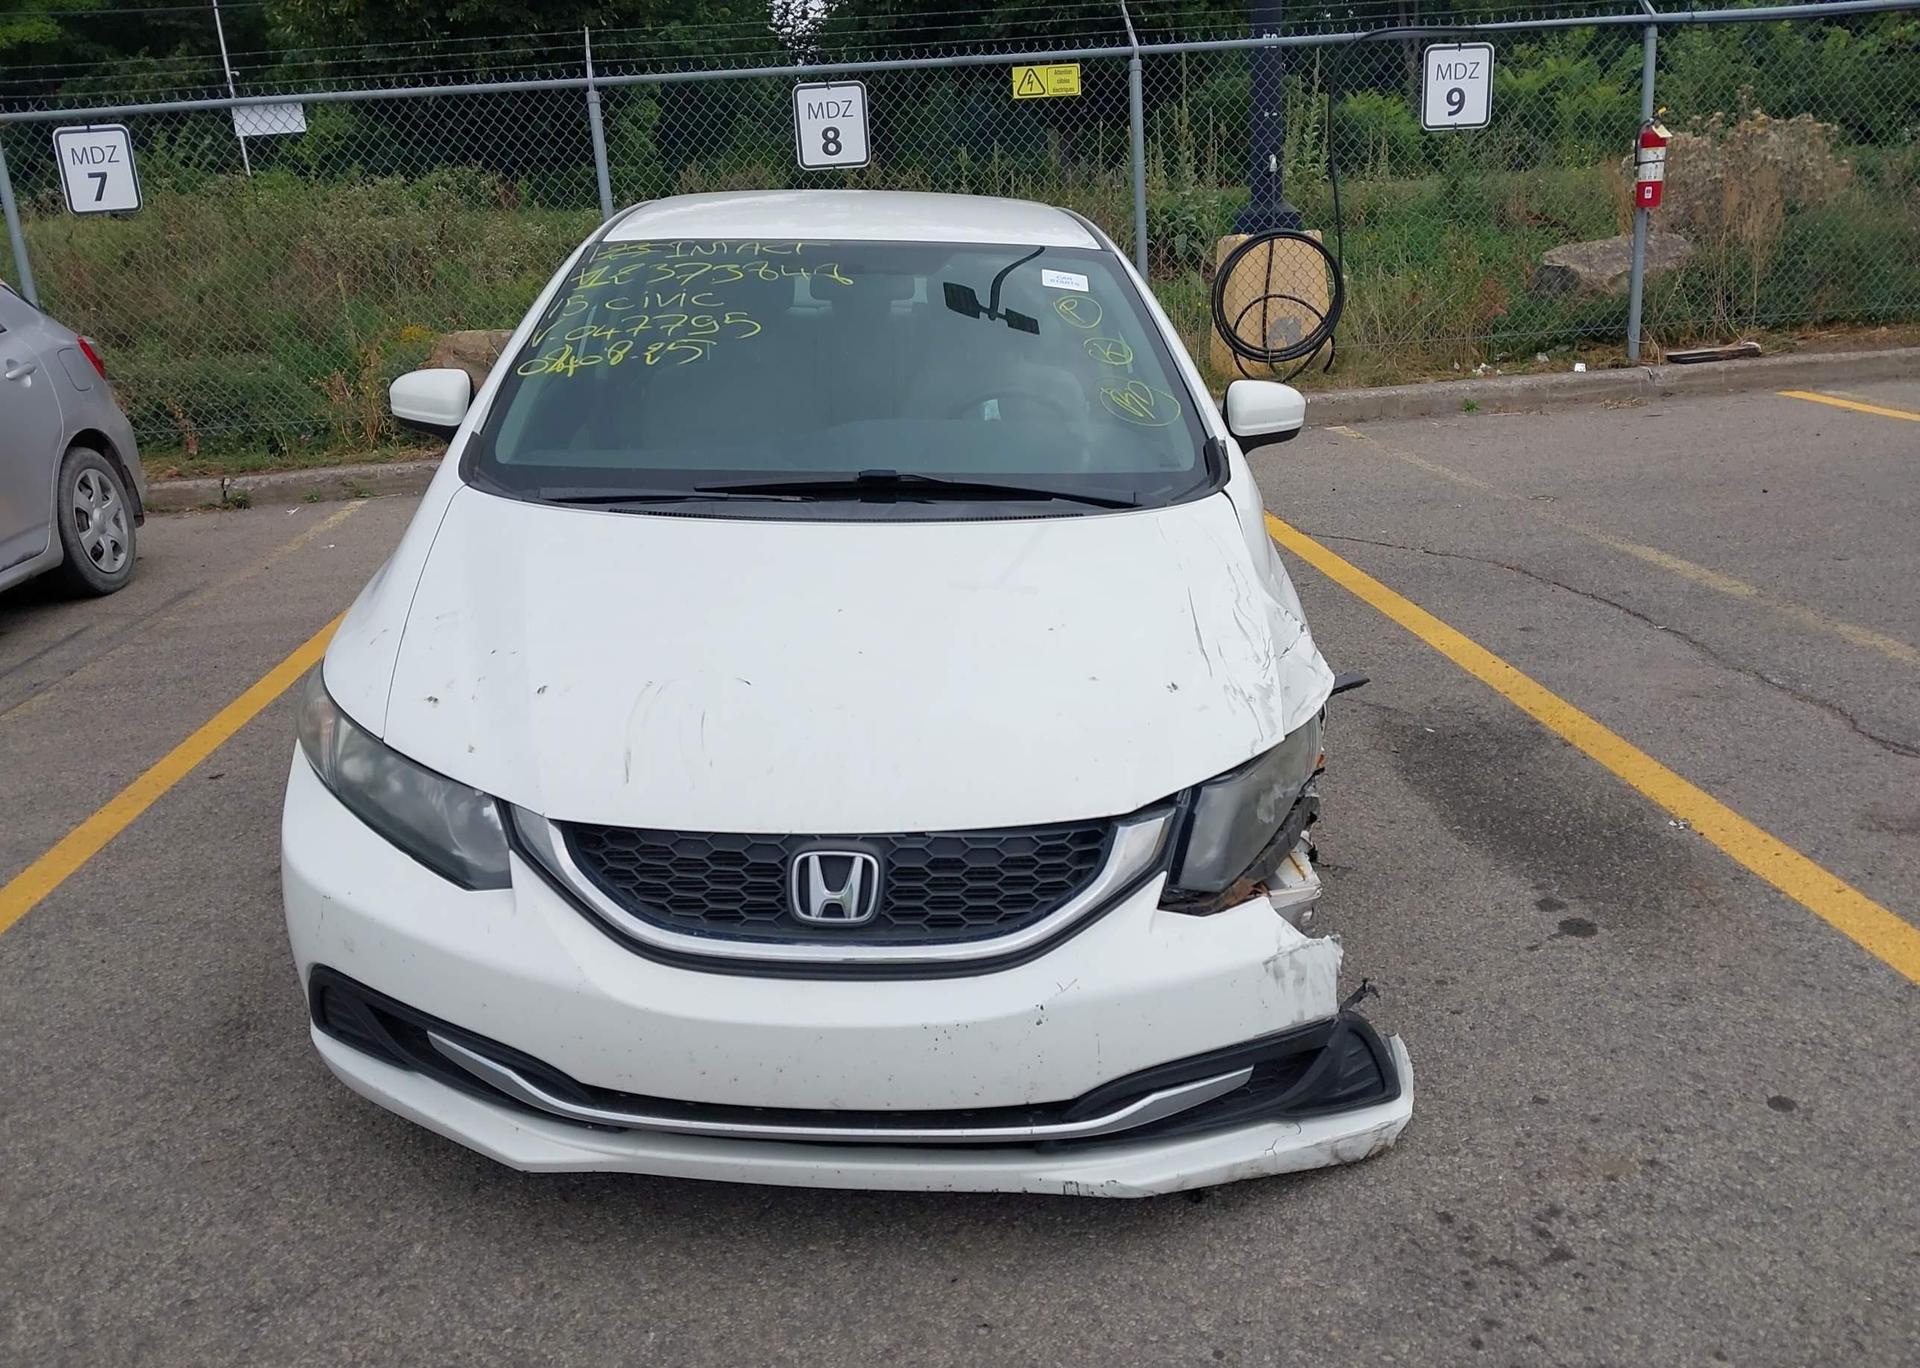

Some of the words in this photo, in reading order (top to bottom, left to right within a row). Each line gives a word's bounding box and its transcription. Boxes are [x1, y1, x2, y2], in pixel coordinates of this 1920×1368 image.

[1435, 61, 1481, 81] MDZ
[807, 99, 854, 121] MDZ
[1446, 87, 1466, 117] 9
[821, 126, 843, 157] 8
[71, 145, 120, 166] MDZ
[87, 171, 108, 202] 7
